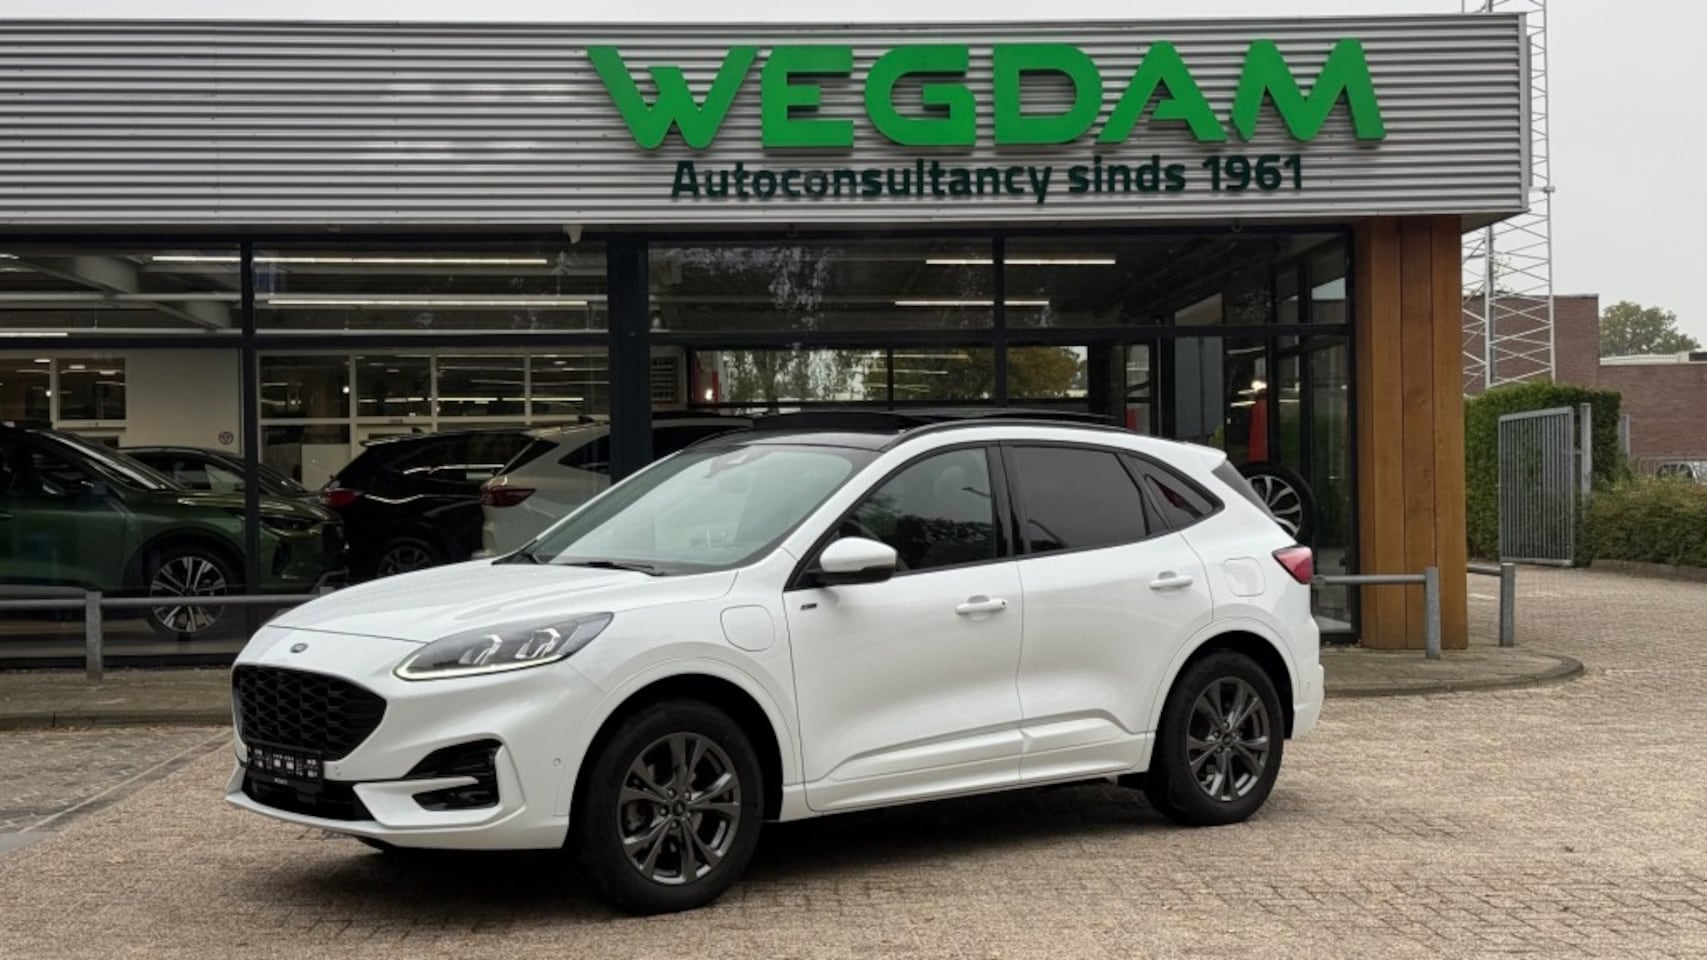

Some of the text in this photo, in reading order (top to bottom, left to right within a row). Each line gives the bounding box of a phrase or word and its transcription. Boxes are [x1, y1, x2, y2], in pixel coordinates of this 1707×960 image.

[587, 38, 1386, 149] WEGDAM
[671, 154, 1305, 205] Autoconsultancy sinds 1961
